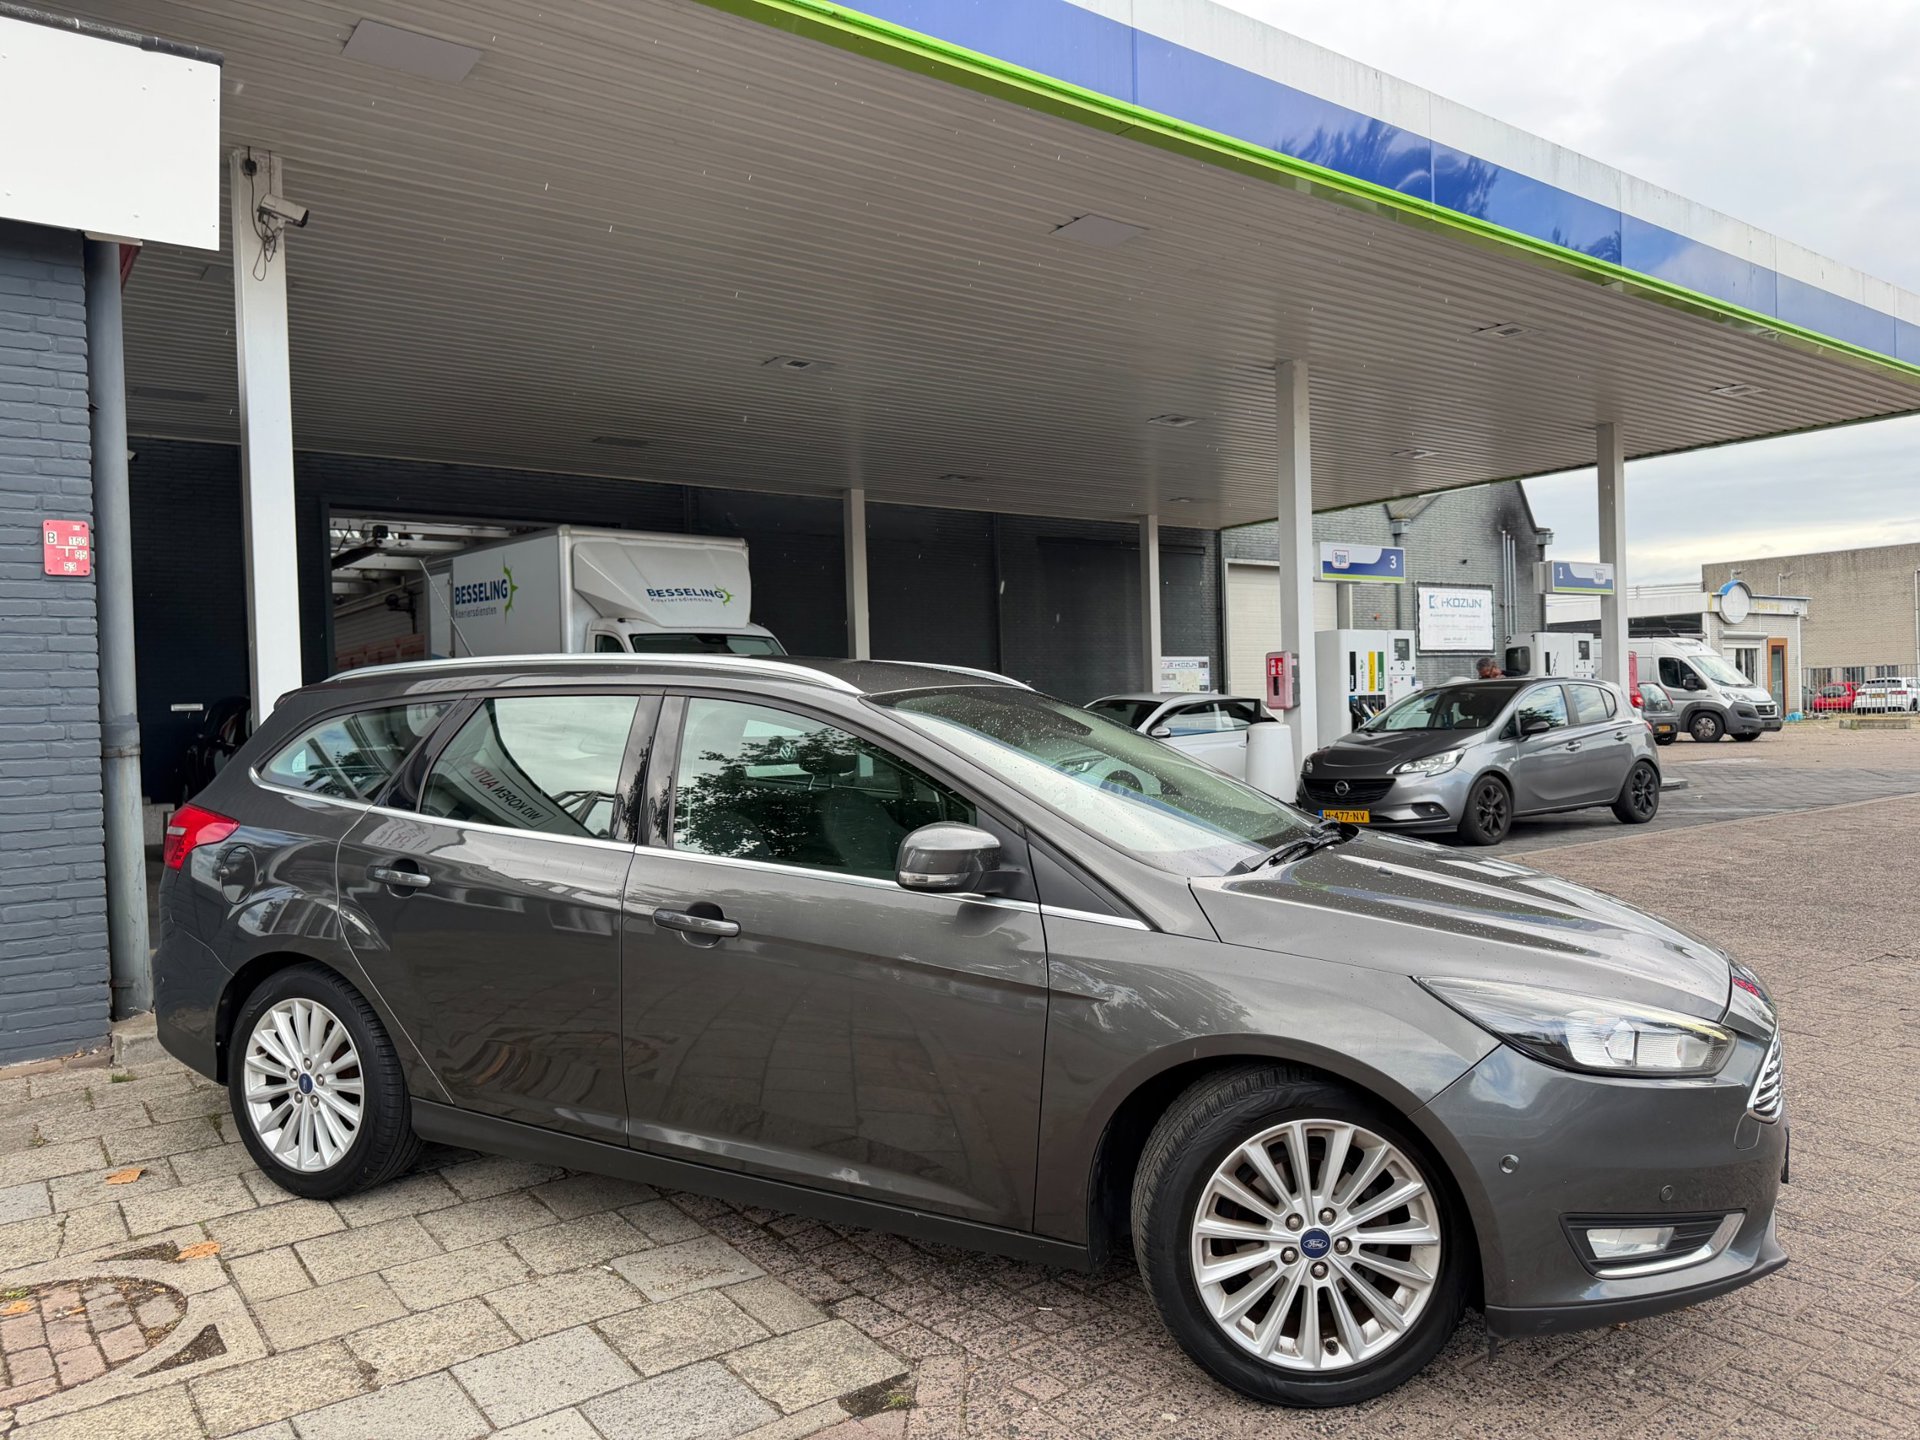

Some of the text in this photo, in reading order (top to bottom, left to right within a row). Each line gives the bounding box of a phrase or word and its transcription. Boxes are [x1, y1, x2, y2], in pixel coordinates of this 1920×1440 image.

[47, 531, 56, 543] B
[70, 537, 86, 545] 150
[75, 551, 87, 559] 95
[1389, 555, 1397, 569] 3
[1559, 566, 1564, 579] 1
[455, 579, 508, 605] BESSELING
[646, 588, 724, 599] BESSELING
[1505, 635, 1512, 644] 2
[1530, 634, 1535, 642] 1
[1400, 661, 1405, 671] 3
